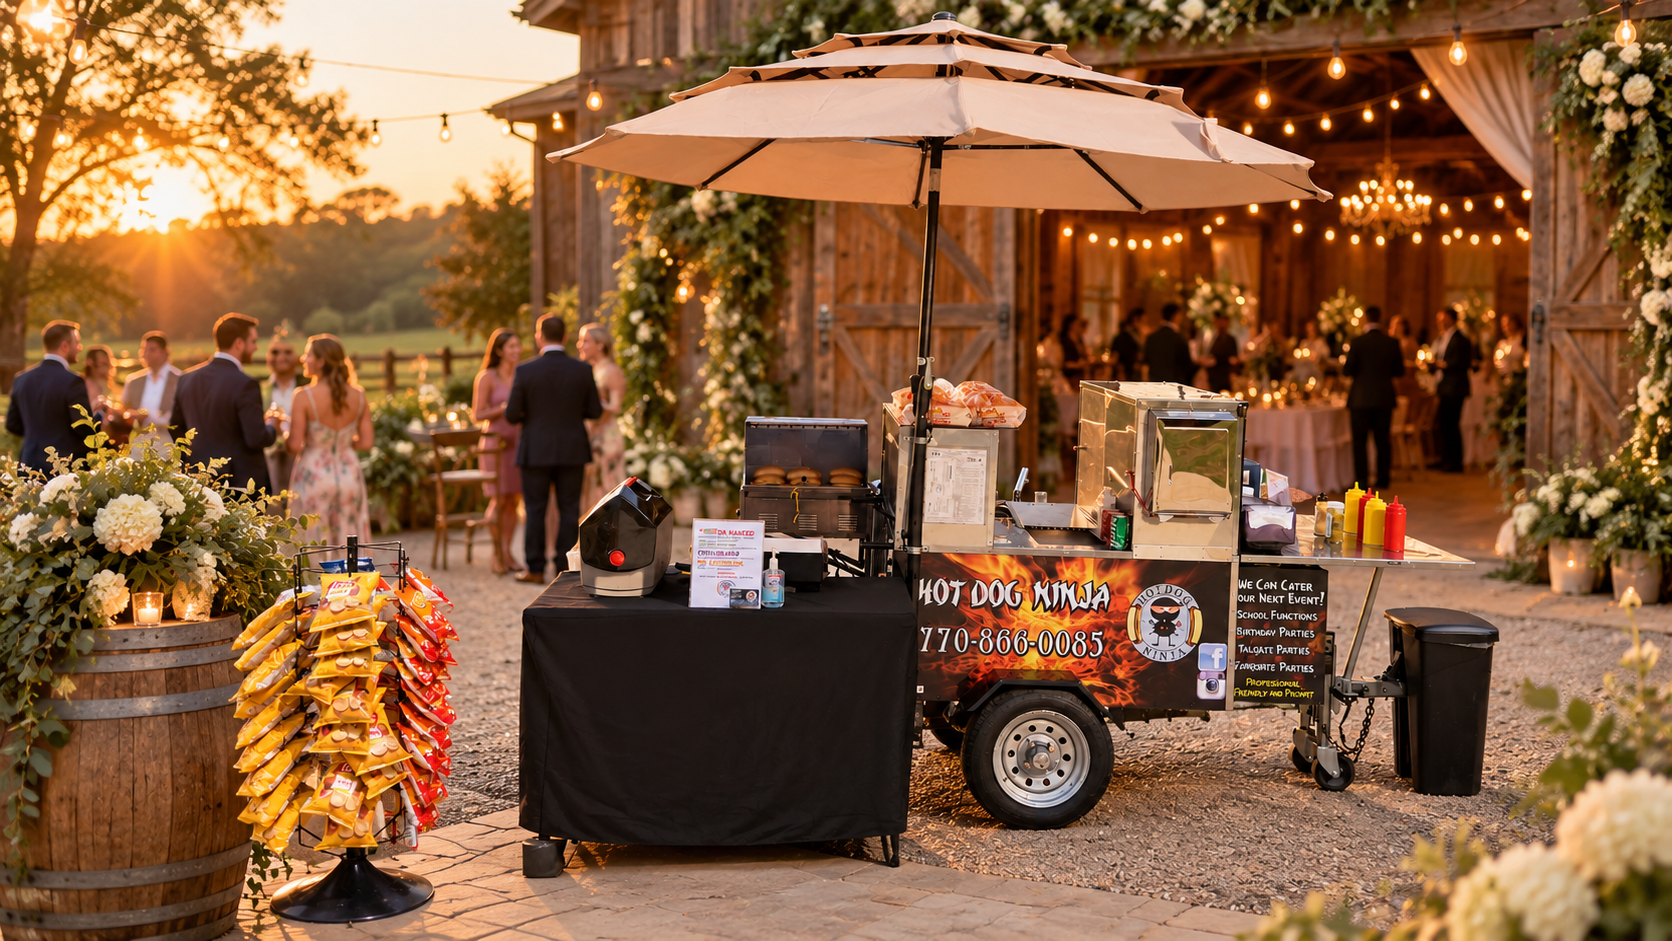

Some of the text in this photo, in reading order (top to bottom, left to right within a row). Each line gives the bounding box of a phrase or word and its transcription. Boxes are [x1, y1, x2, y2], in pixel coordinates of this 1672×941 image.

[1238, 578, 1313, 592] WE CAN CATER
[918, 578, 1110, 613] HOT DOG NINJA
[1259, 592, 1285, 604] NEXT
[1288, 591, 1325, 606] EVENT!
[1237, 609, 1318, 621] SCHOOL FUNCTIONS
[1279, 626, 1315, 639] PARTIES
[920, 626, 1103, 658] 770-866-0085
[1279, 661, 1314, 673] PARTIES
